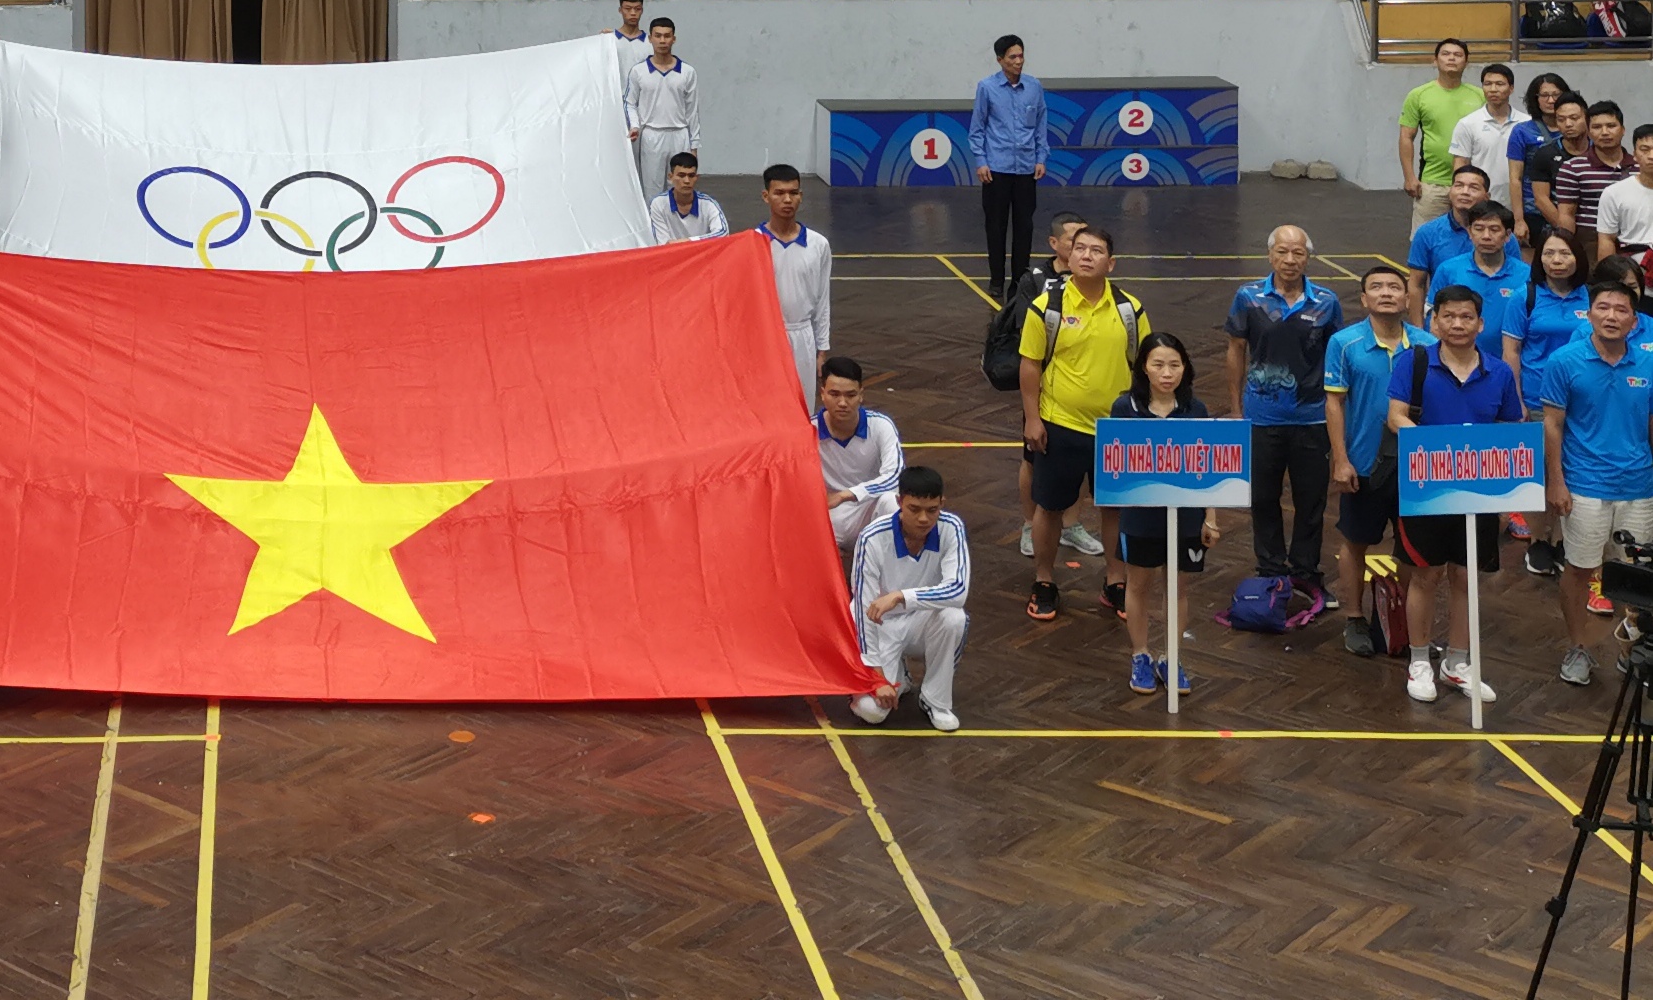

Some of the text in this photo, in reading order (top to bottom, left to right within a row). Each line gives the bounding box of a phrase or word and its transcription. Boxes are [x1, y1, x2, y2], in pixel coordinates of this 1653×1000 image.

[1127, 108, 1145, 128] 2
[923, 138, 939, 160] 1
[1128, 158, 1143, 174] 3
[1103, 438, 1243, 481] HỘI NHÀ BÁO VIỆT NAM
[1409, 442, 1534, 489] HỘI NHÀ BÁO HƯNG YÊN
